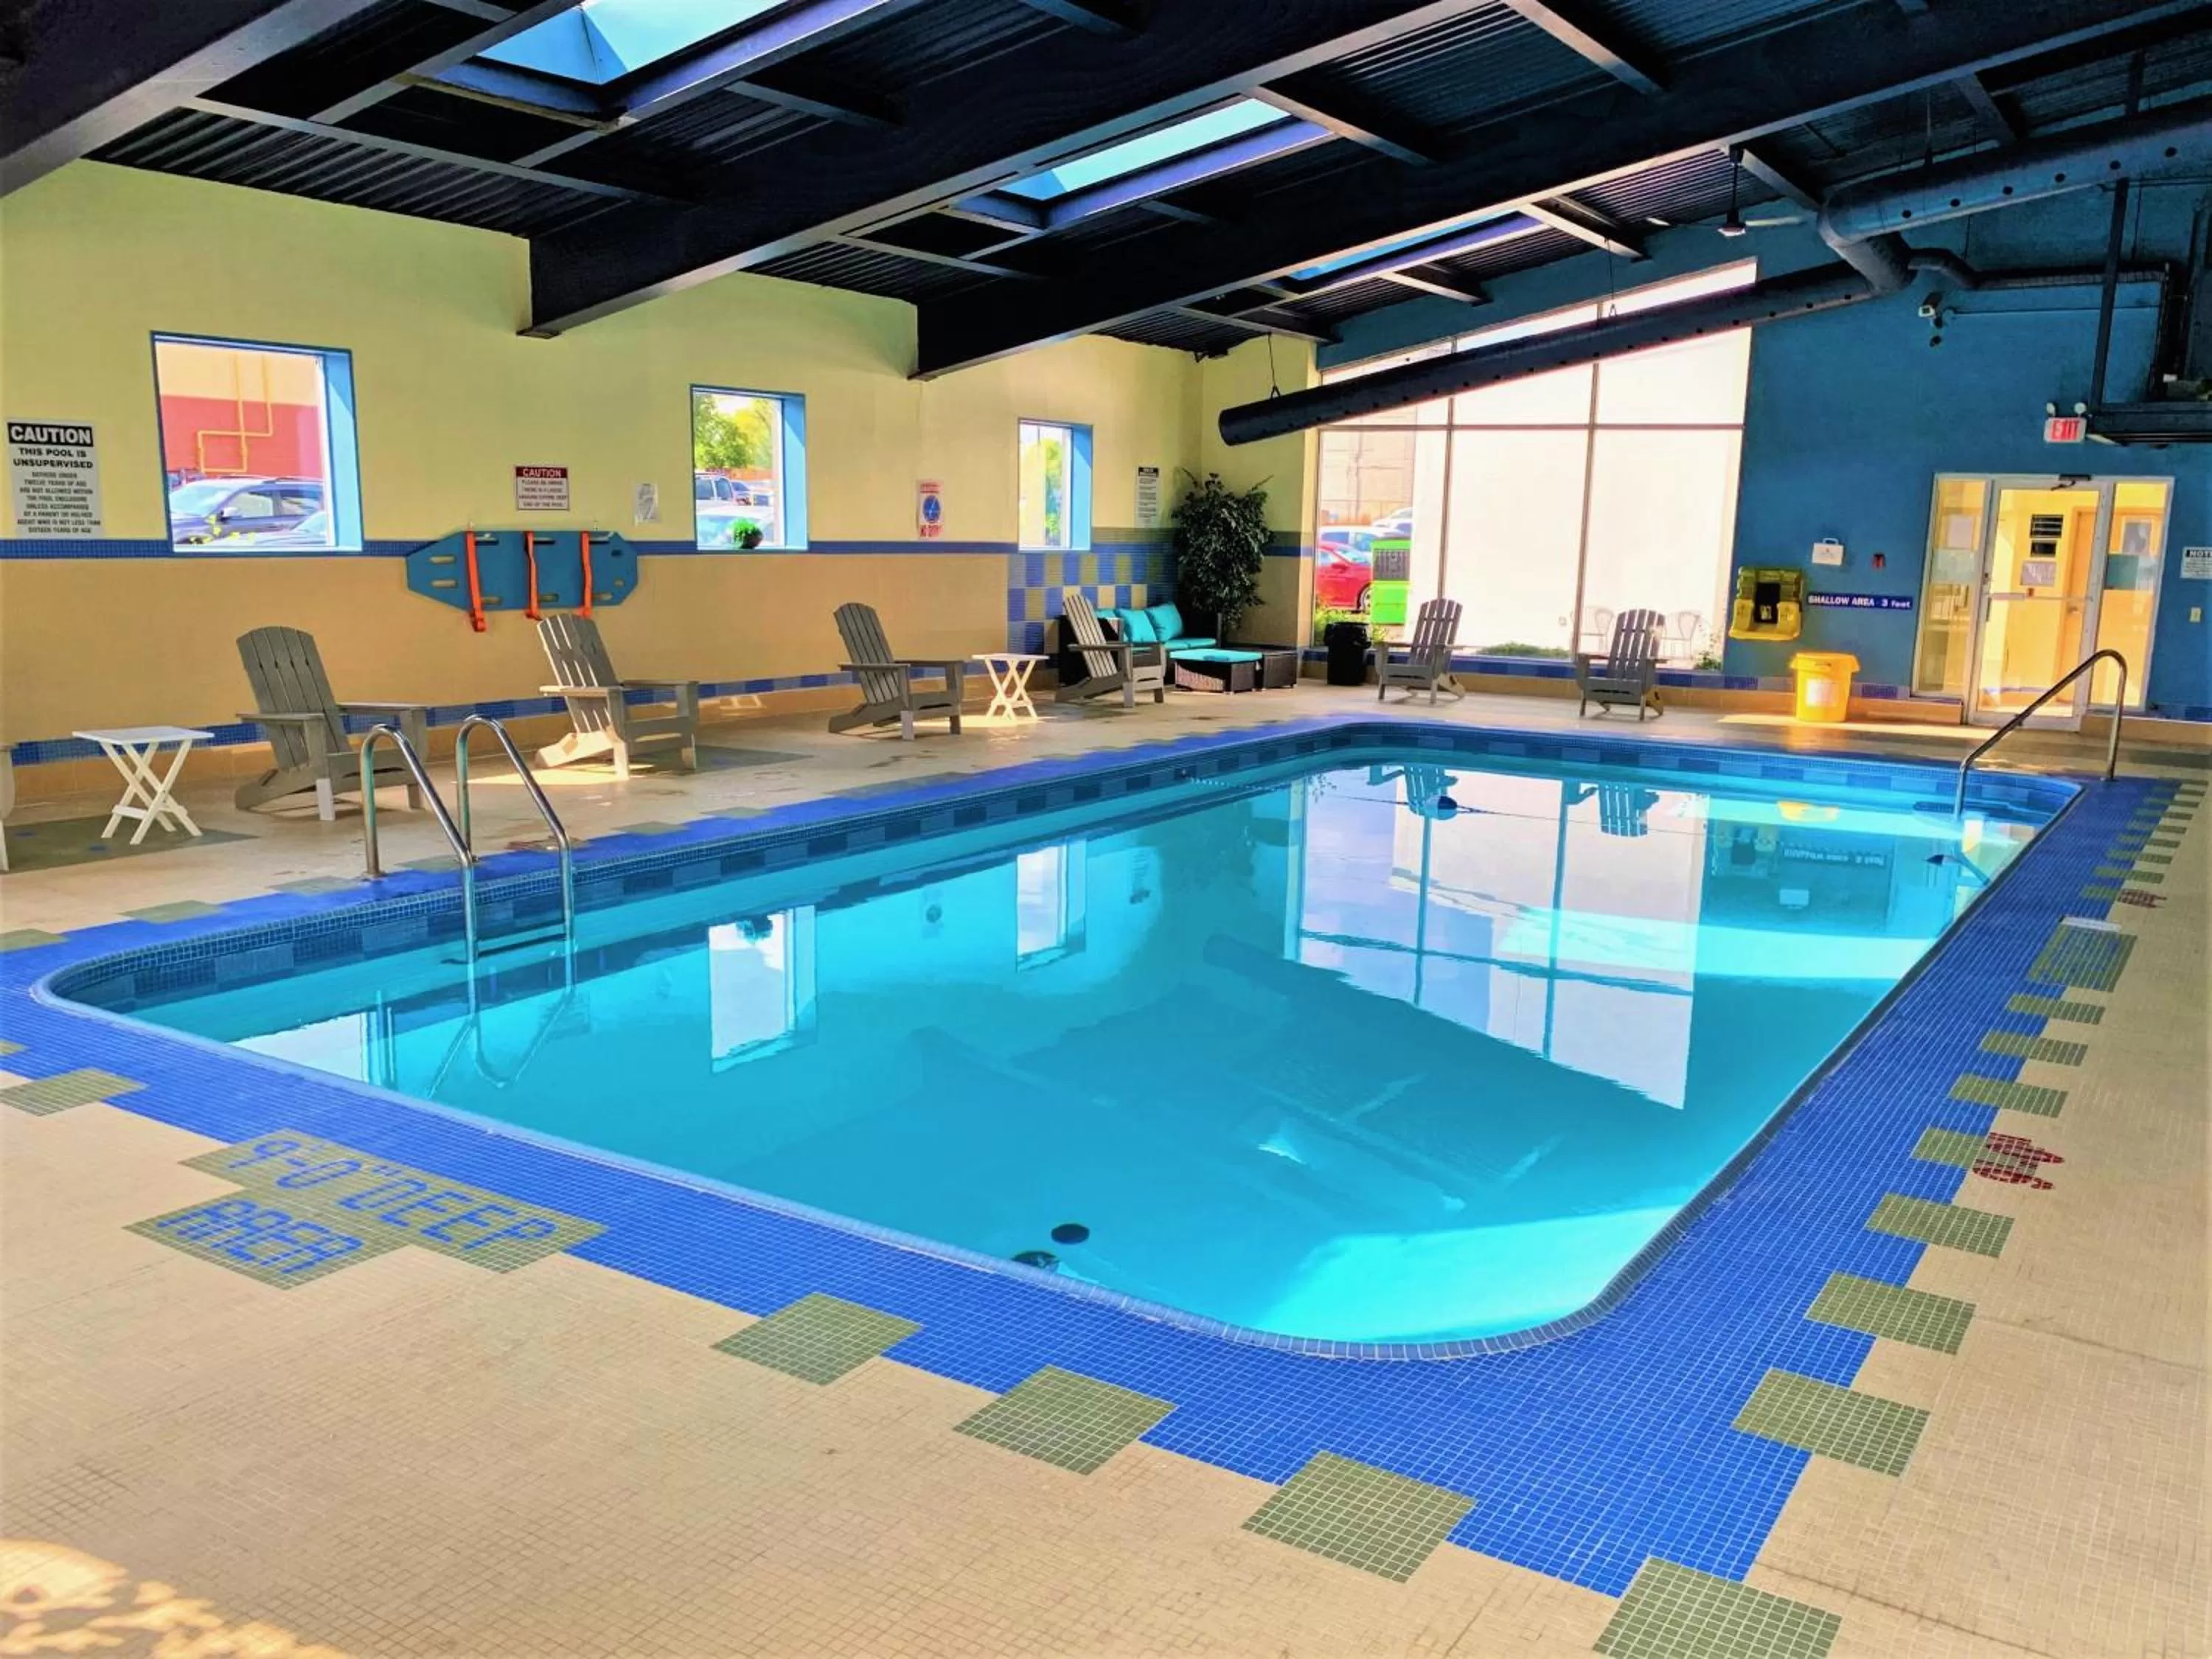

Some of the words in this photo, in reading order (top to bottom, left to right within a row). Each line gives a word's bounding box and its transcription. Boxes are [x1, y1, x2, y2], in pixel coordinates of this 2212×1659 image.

[11, 425, 91, 444] CAUTION
[2051, 419, 2080, 440] EXIT
[18, 448, 42, 456] THIS
[46, 448, 73, 456] POOL
[77, 450, 86, 458] IS
[13, 458, 94, 468] UNSUPERVISED
[523, 468, 561, 478] CAUTION
[1808, 594, 1850, 605] SHALLOW
[1852, 597, 1875, 607] AREA
[1891, 600, 1910, 608] feet
[336, 1179, 558, 1251] DEEP
